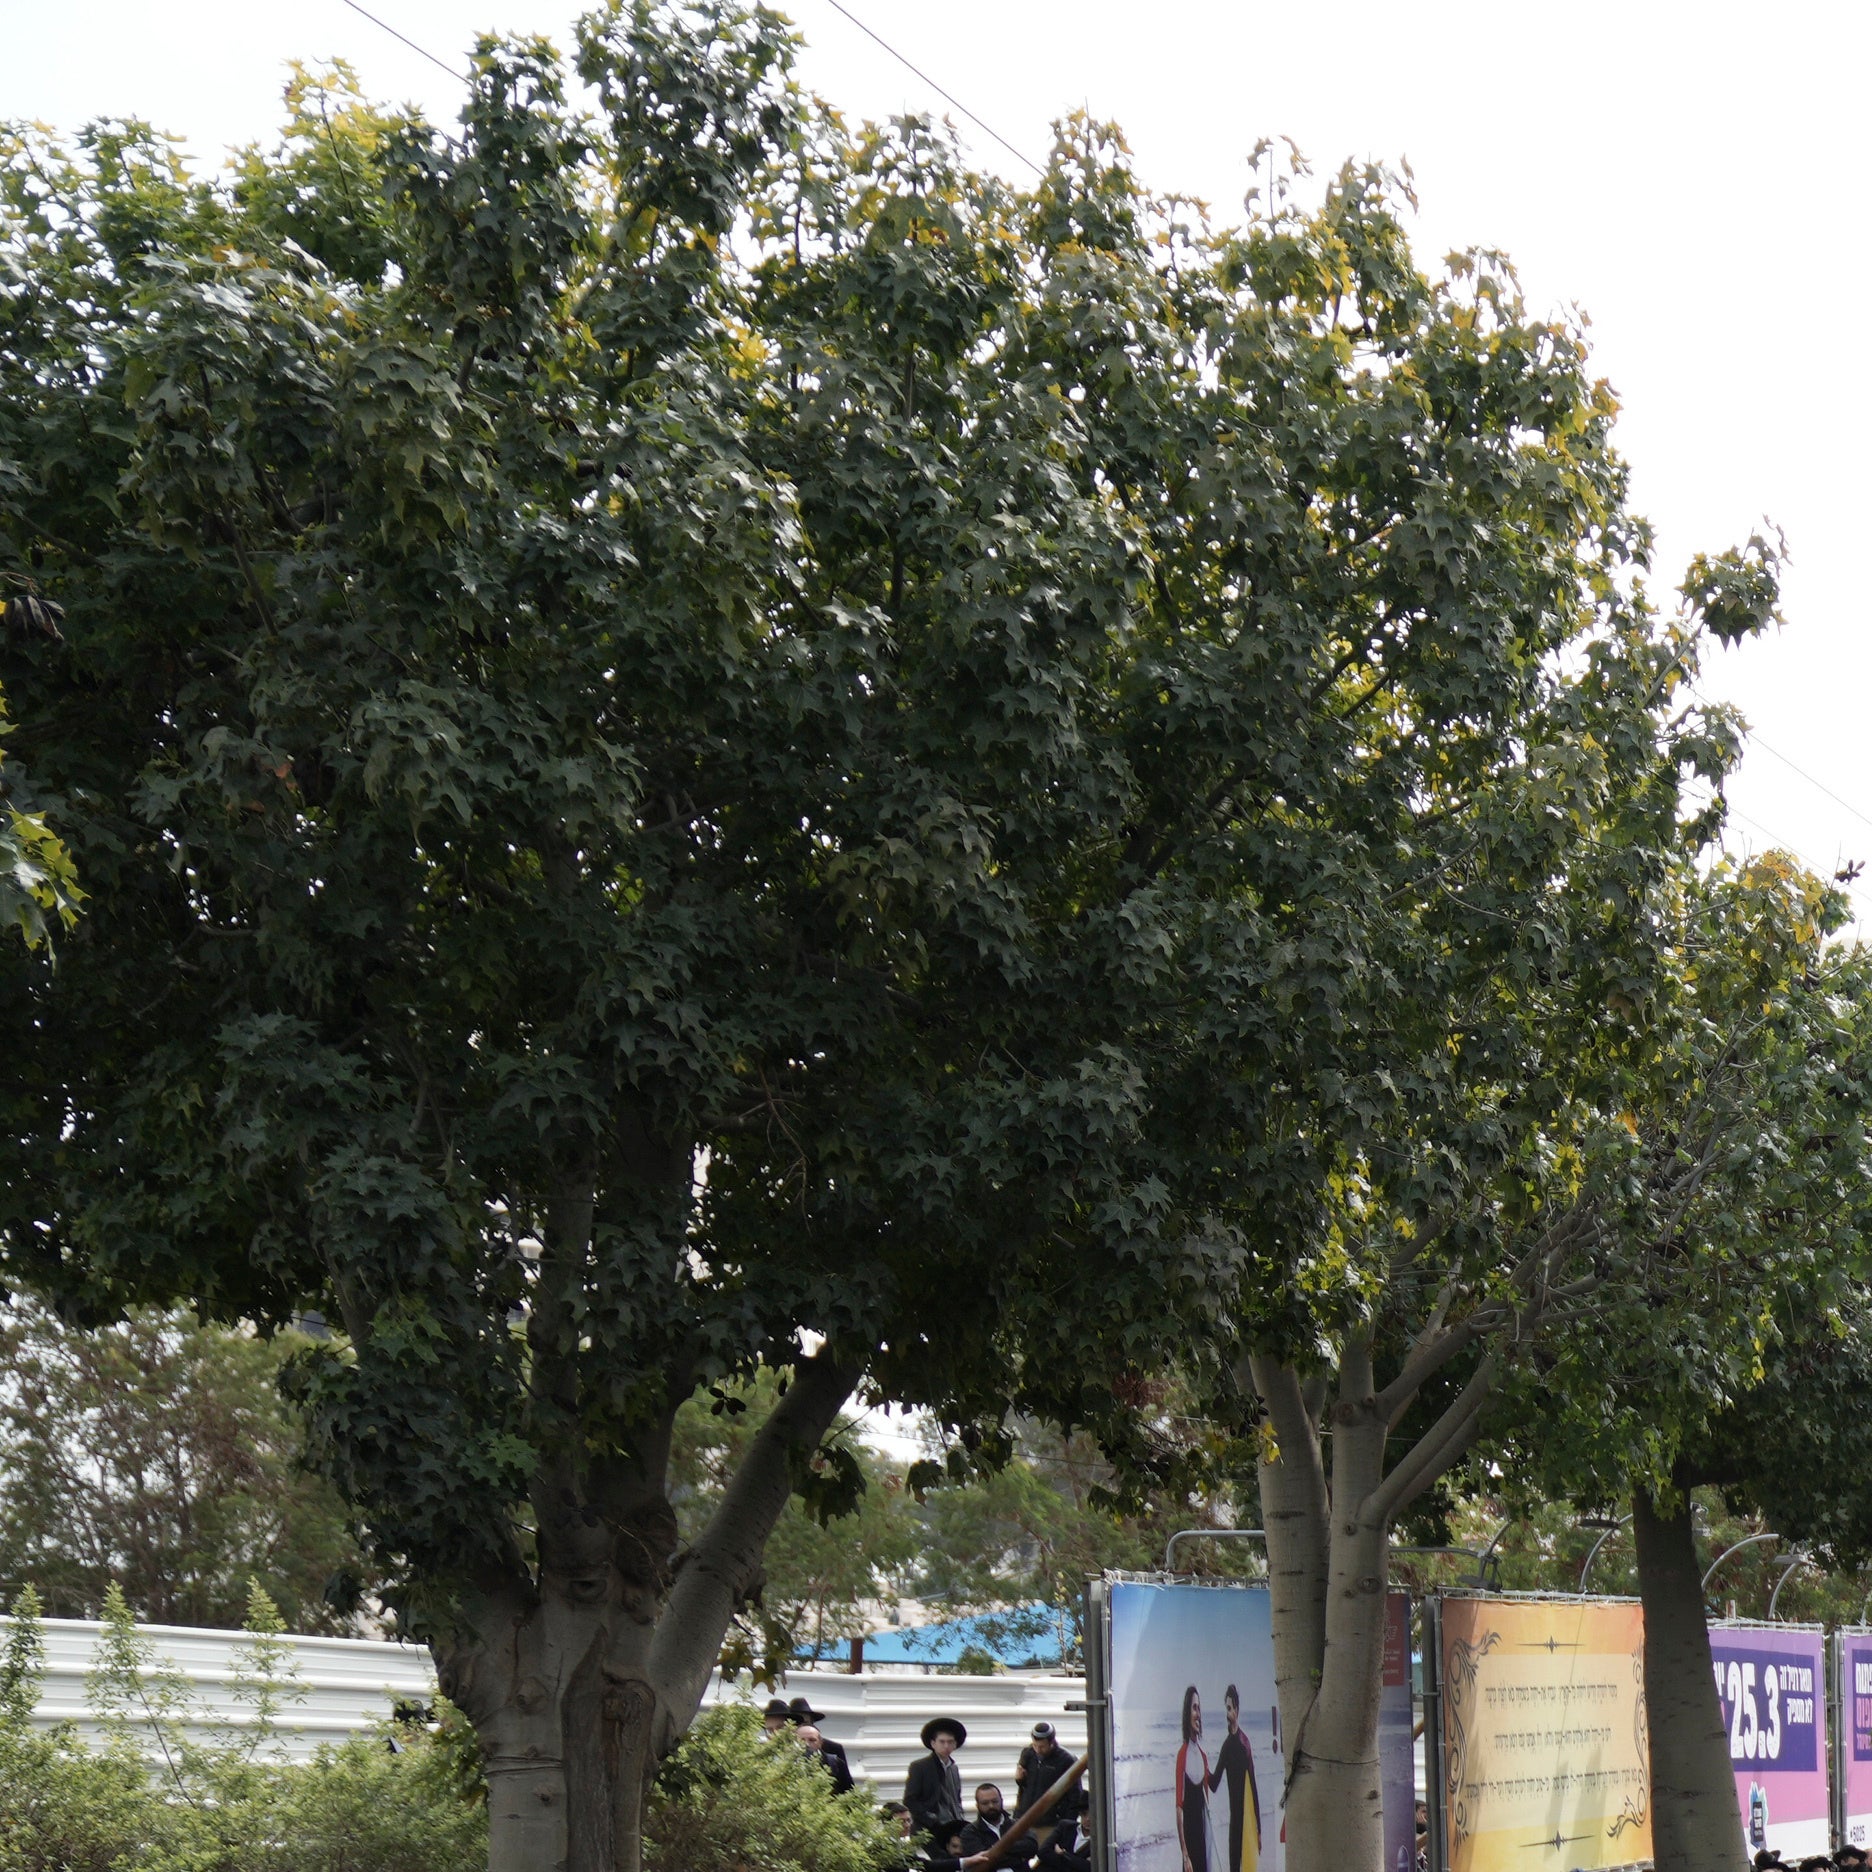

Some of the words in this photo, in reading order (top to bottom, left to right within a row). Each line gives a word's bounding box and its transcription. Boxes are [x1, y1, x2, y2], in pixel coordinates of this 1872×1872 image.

[1786, 1664, 1799, 1692] רגיל
[1799, 1667, 1813, 1692] תואר
[1727, 1661, 1781, 1759] 25.3
[1786, 1698, 1804, 1725] מספיק
[1804, 1697, 1813, 1724] לא
